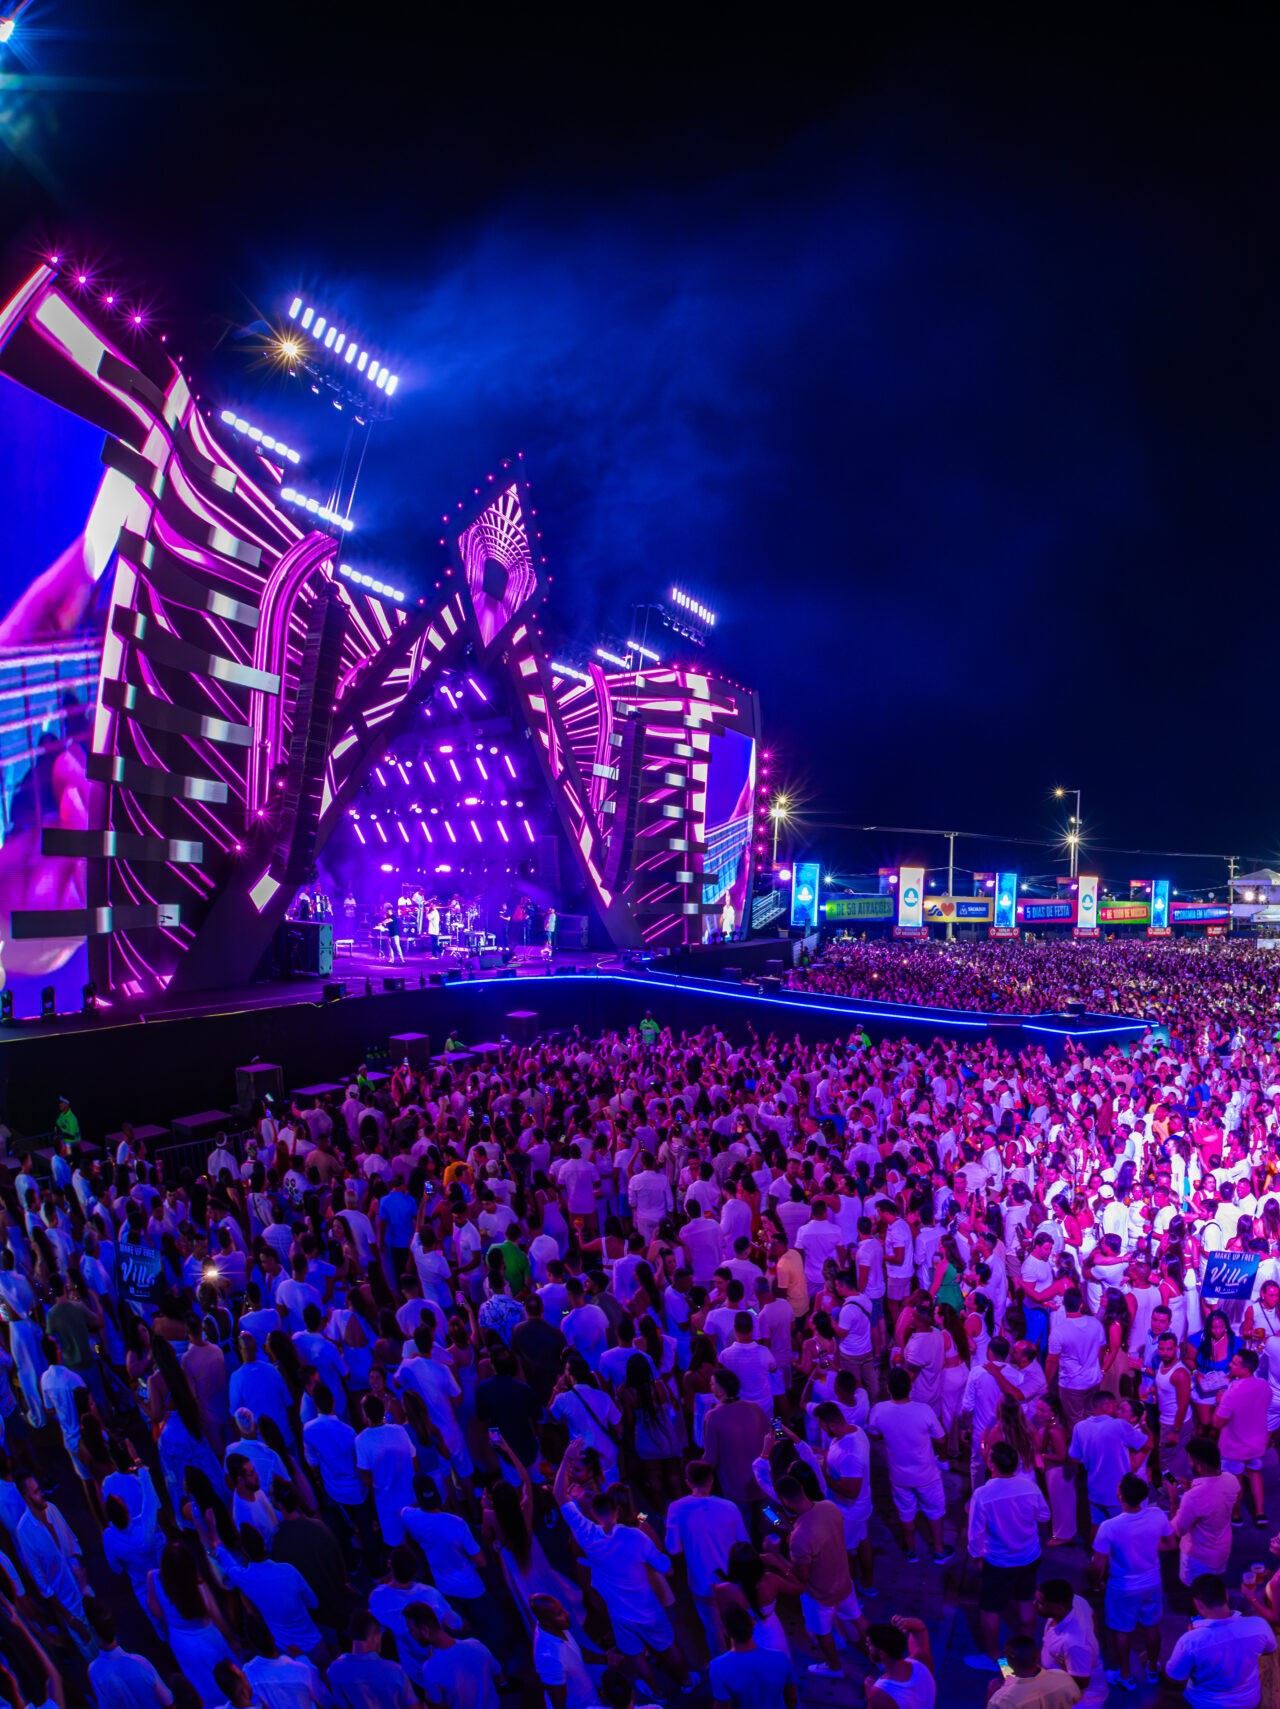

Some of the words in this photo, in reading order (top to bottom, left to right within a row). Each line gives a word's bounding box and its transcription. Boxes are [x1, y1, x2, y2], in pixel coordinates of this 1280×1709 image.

[1026, 907, 1031, 919] 5
[1032, 906, 1045, 918] DIAS
[1046, 905, 1053, 917] DE
[1054, 905, 1070, 917] FESTA
[1214, 1252, 1230, 1260] MAKE
[1232, 1253, 1240, 1261] UP
[1211, 1263, 1248, 1284] Villa
